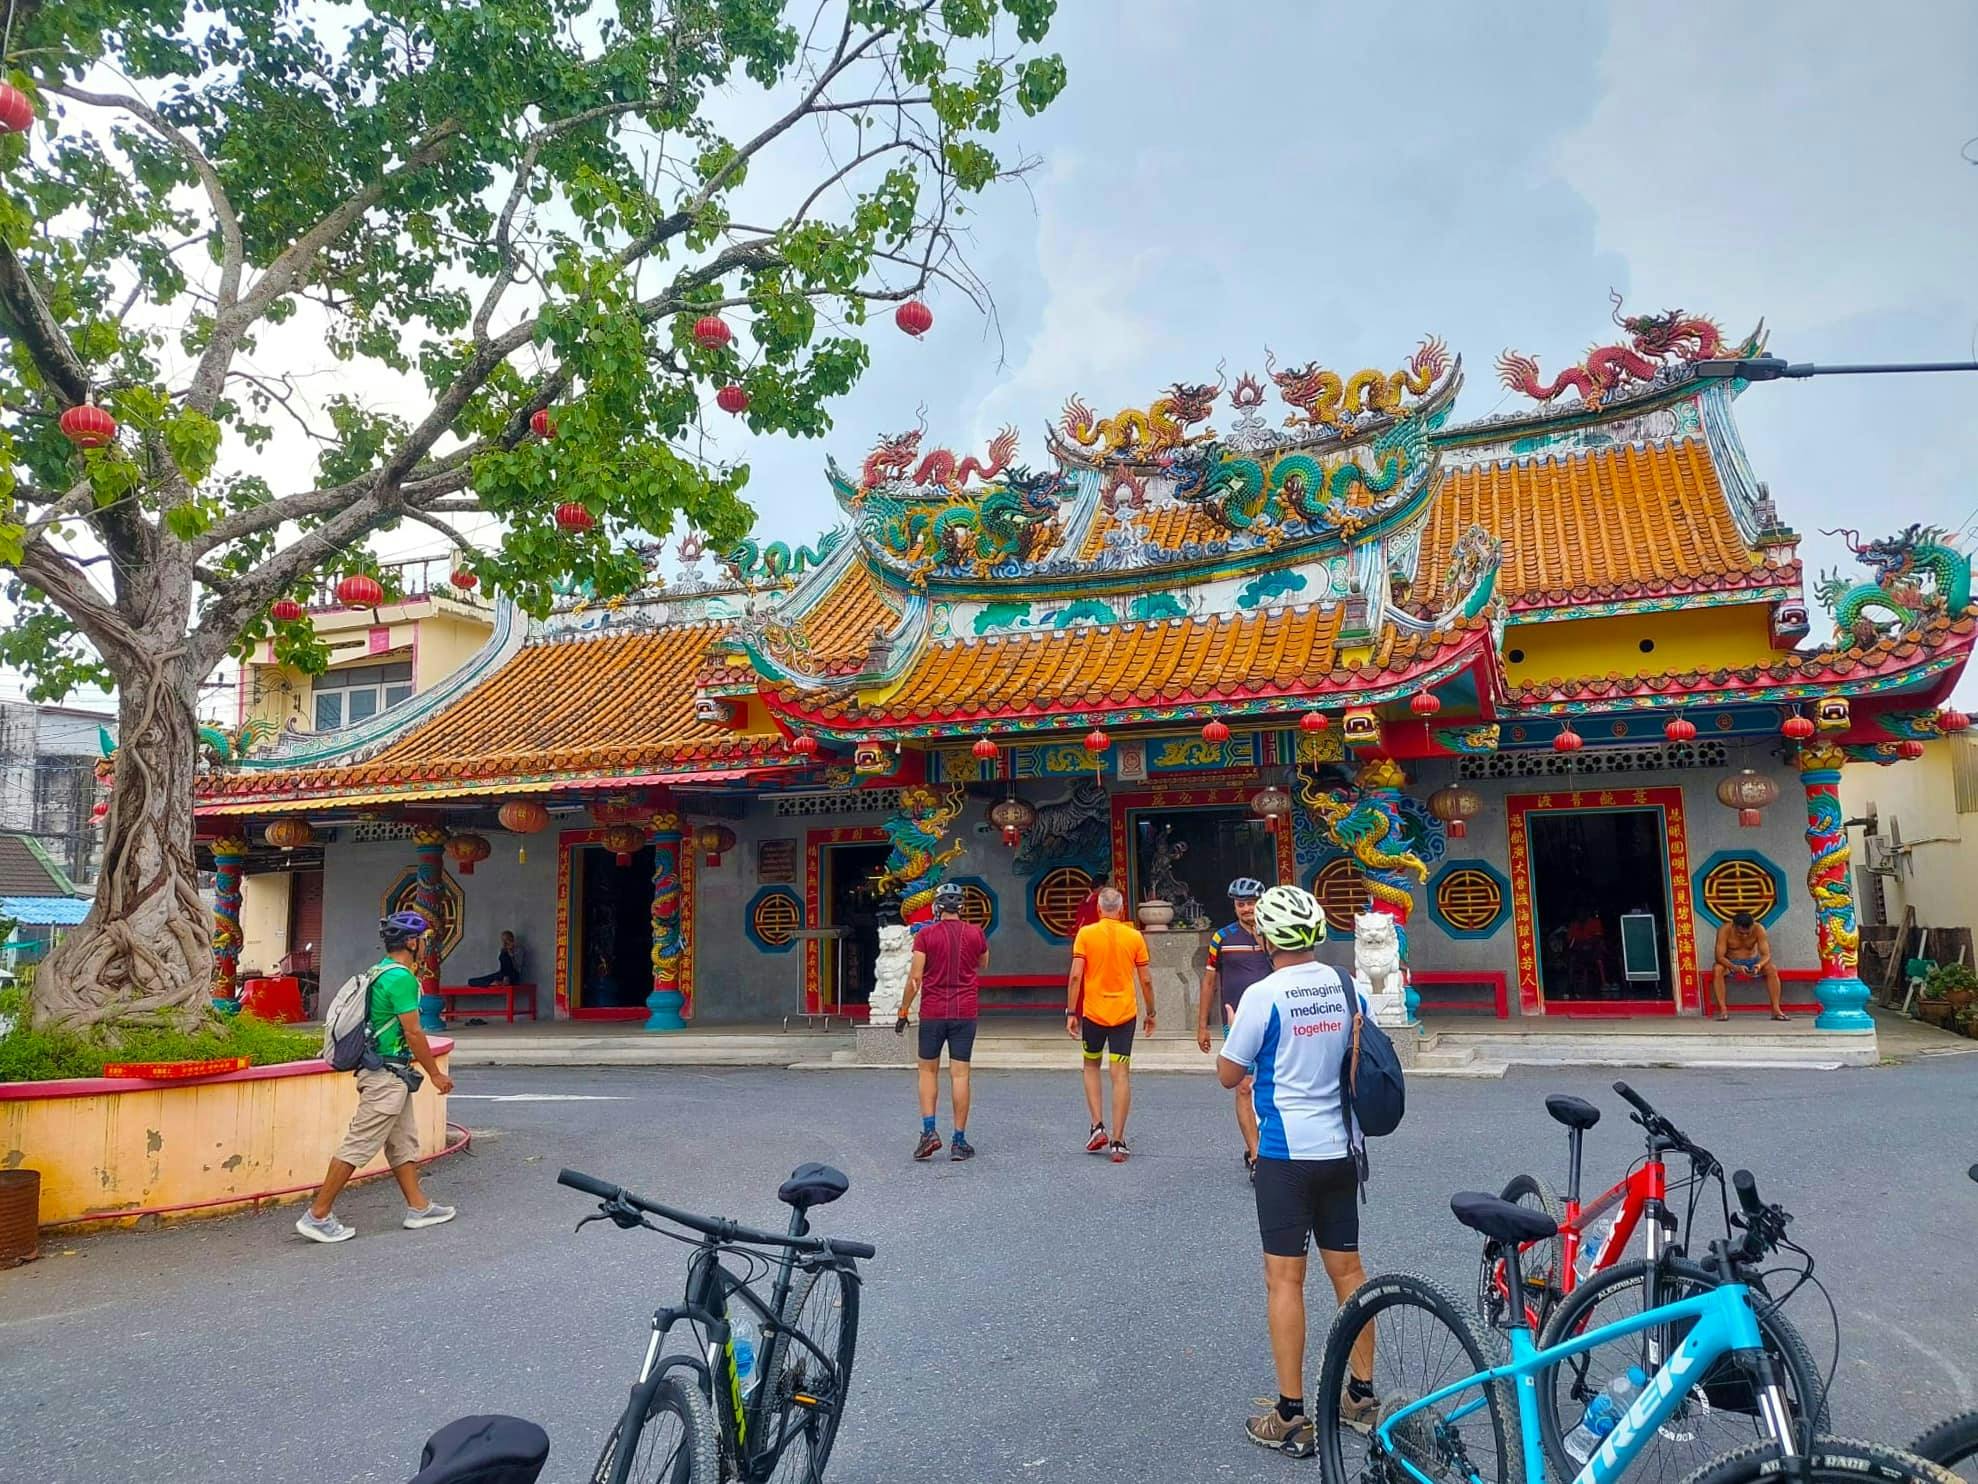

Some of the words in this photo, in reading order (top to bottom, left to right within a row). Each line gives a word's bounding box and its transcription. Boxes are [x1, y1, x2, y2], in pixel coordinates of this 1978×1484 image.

[1285, 983, 1344, 999] reimaginin
[1290, 1002, 1345, 1018] medicine,
[1293, 1020, 1342, 1037] together
[1572, 1338, 1695, 1484] TREK
